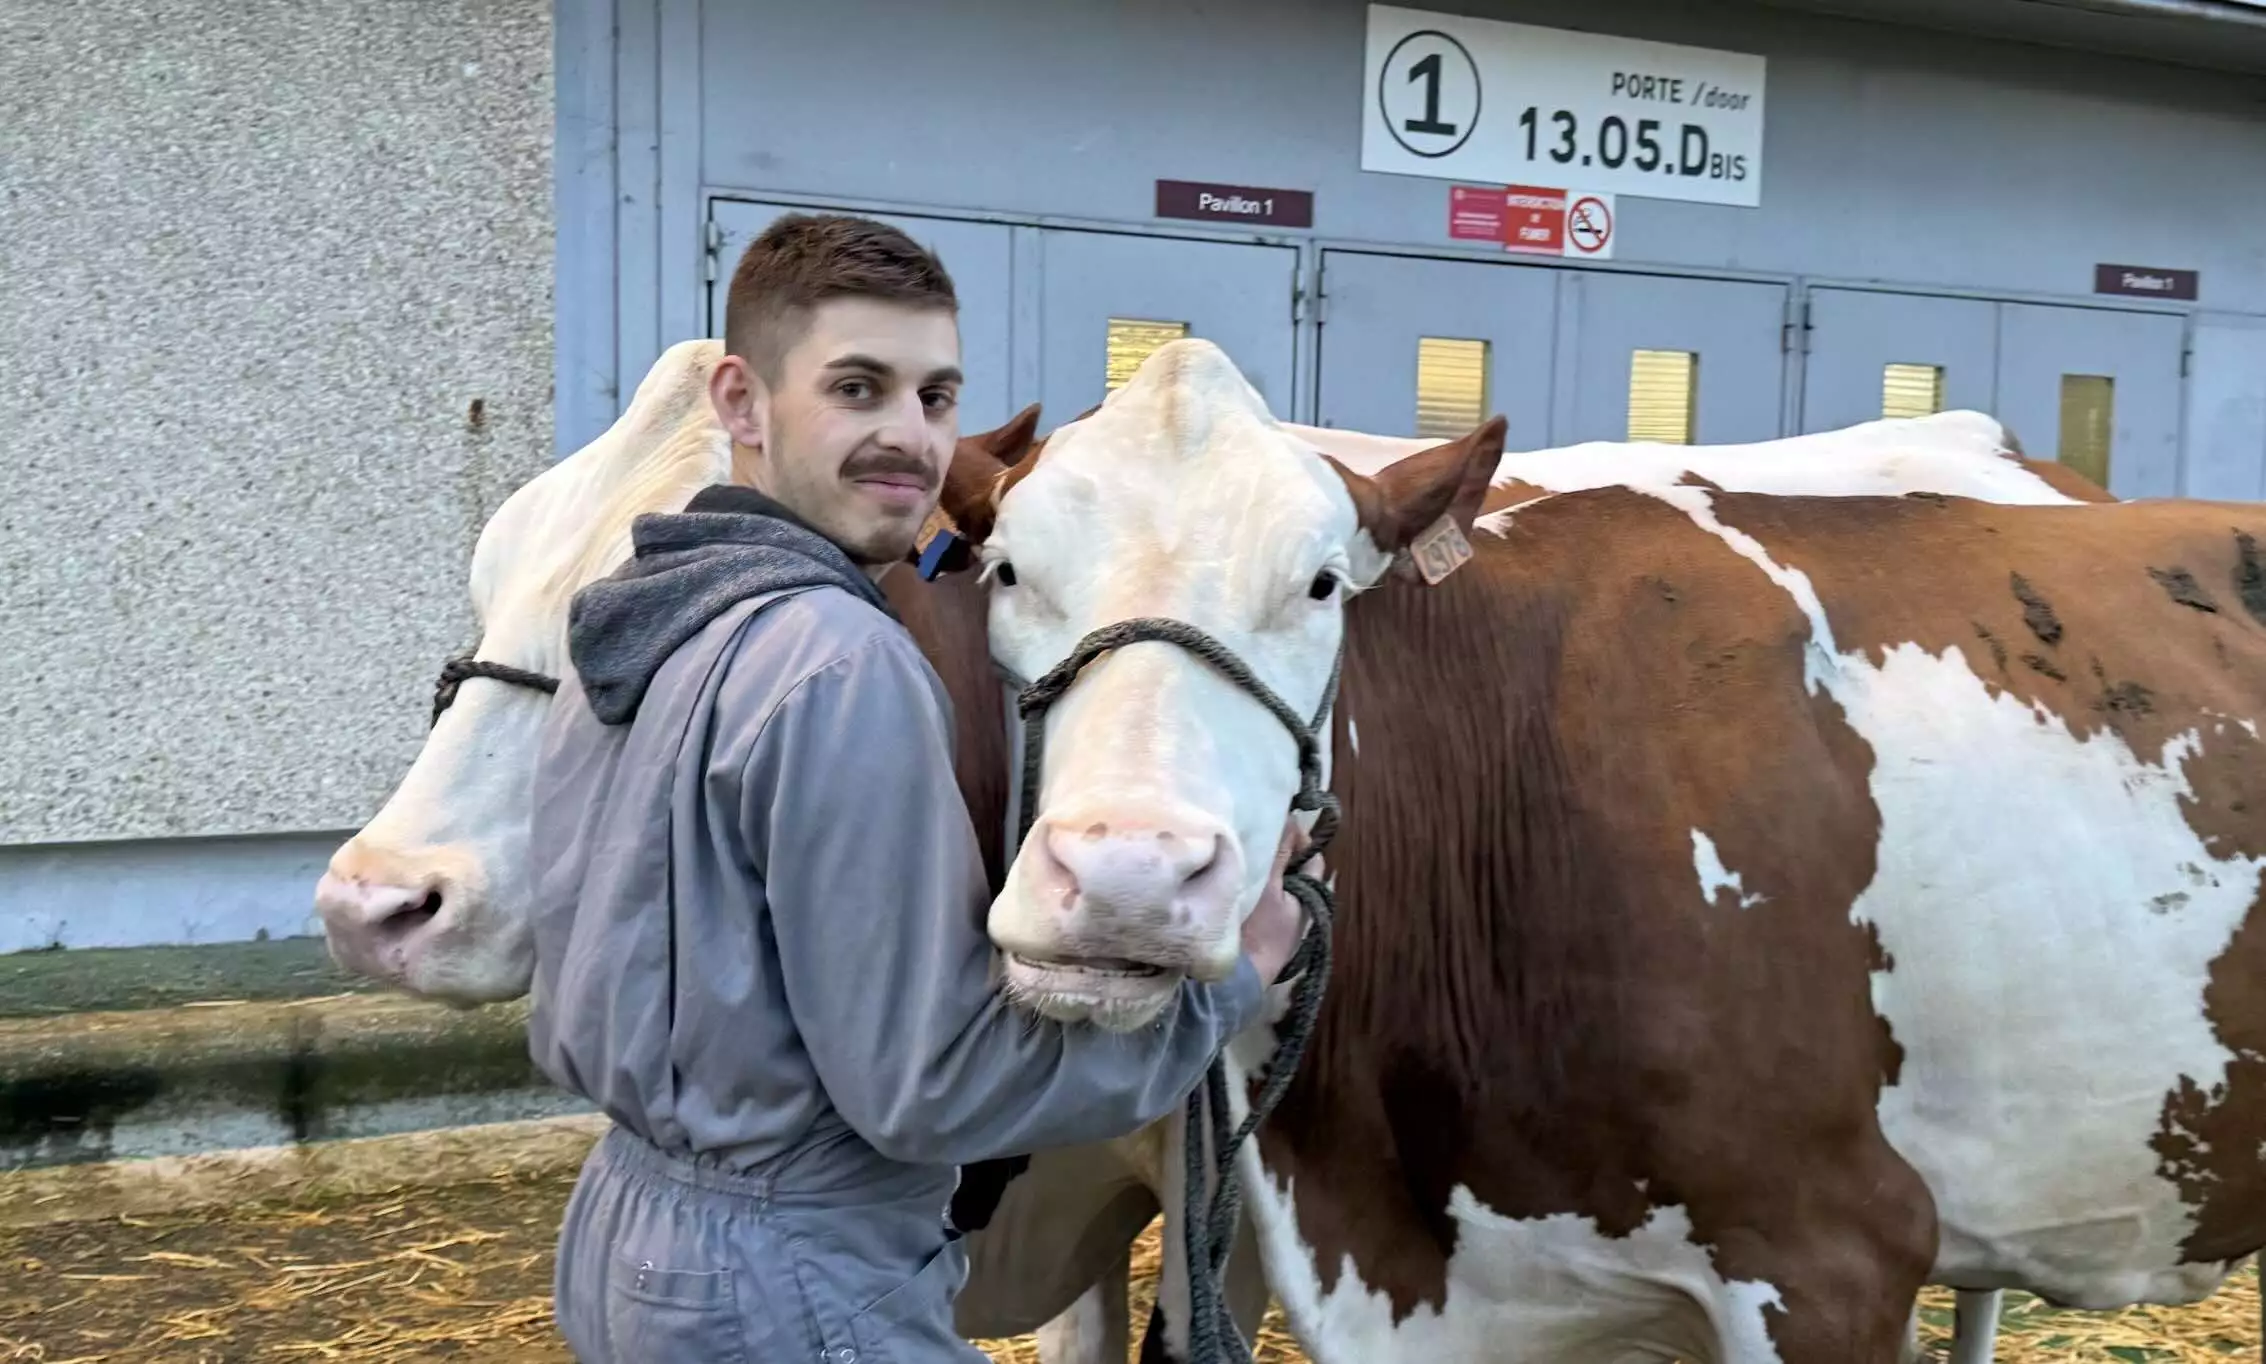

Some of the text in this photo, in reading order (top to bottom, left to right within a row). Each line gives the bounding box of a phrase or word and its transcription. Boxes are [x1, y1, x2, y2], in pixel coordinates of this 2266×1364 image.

[1404, 53, 1457, 136] 1
[1611, 71, 1683, 104] PORTE
[1264, 198, 1273, 216] 1
